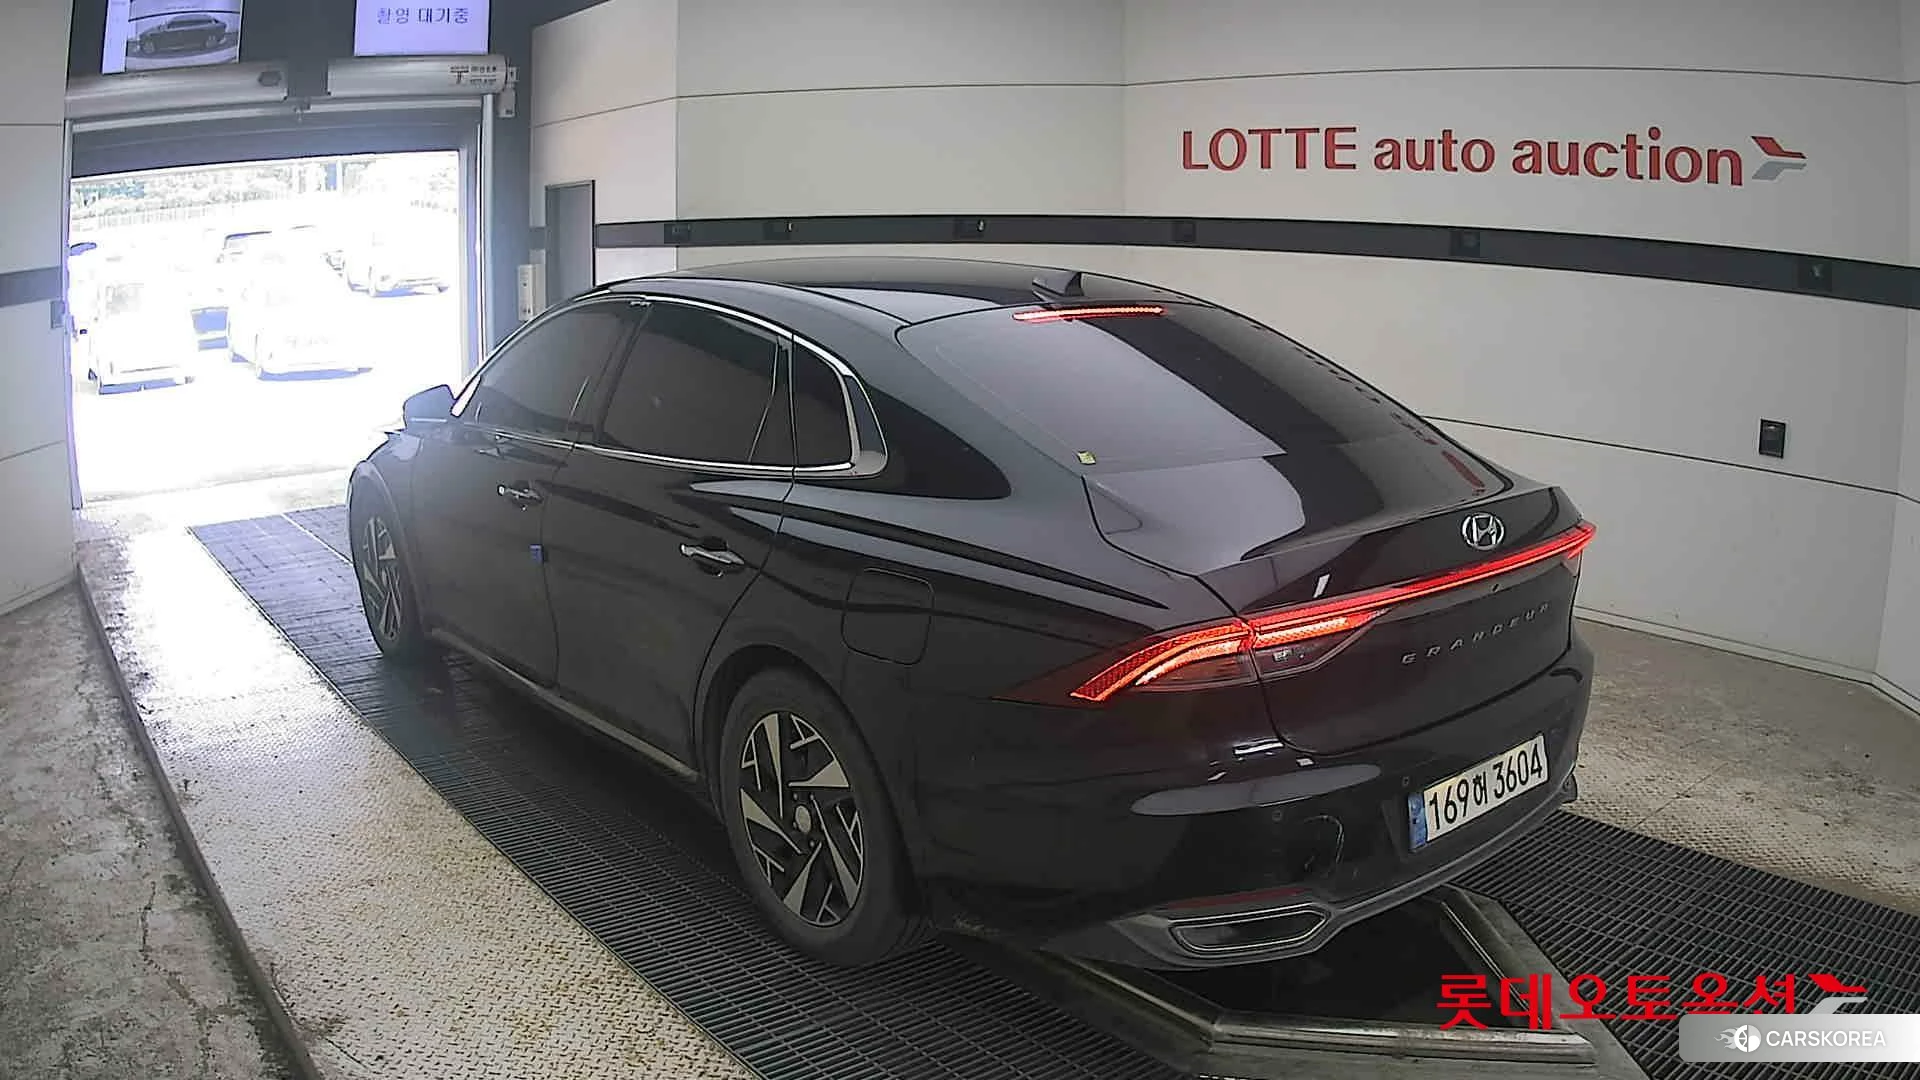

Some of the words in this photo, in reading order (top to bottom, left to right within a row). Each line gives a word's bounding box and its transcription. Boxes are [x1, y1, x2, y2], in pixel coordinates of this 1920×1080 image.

[418, 7, 469, 24] 대기중
[1182, 127, 1357, 171] LOTTE
[1374, 129, 1496, 172] auto
[1512, 126, 1744, 187] auction
[1401, 602, 1549, 664] GRANDEUR
[1492, 743, 1543, 799] 3604
